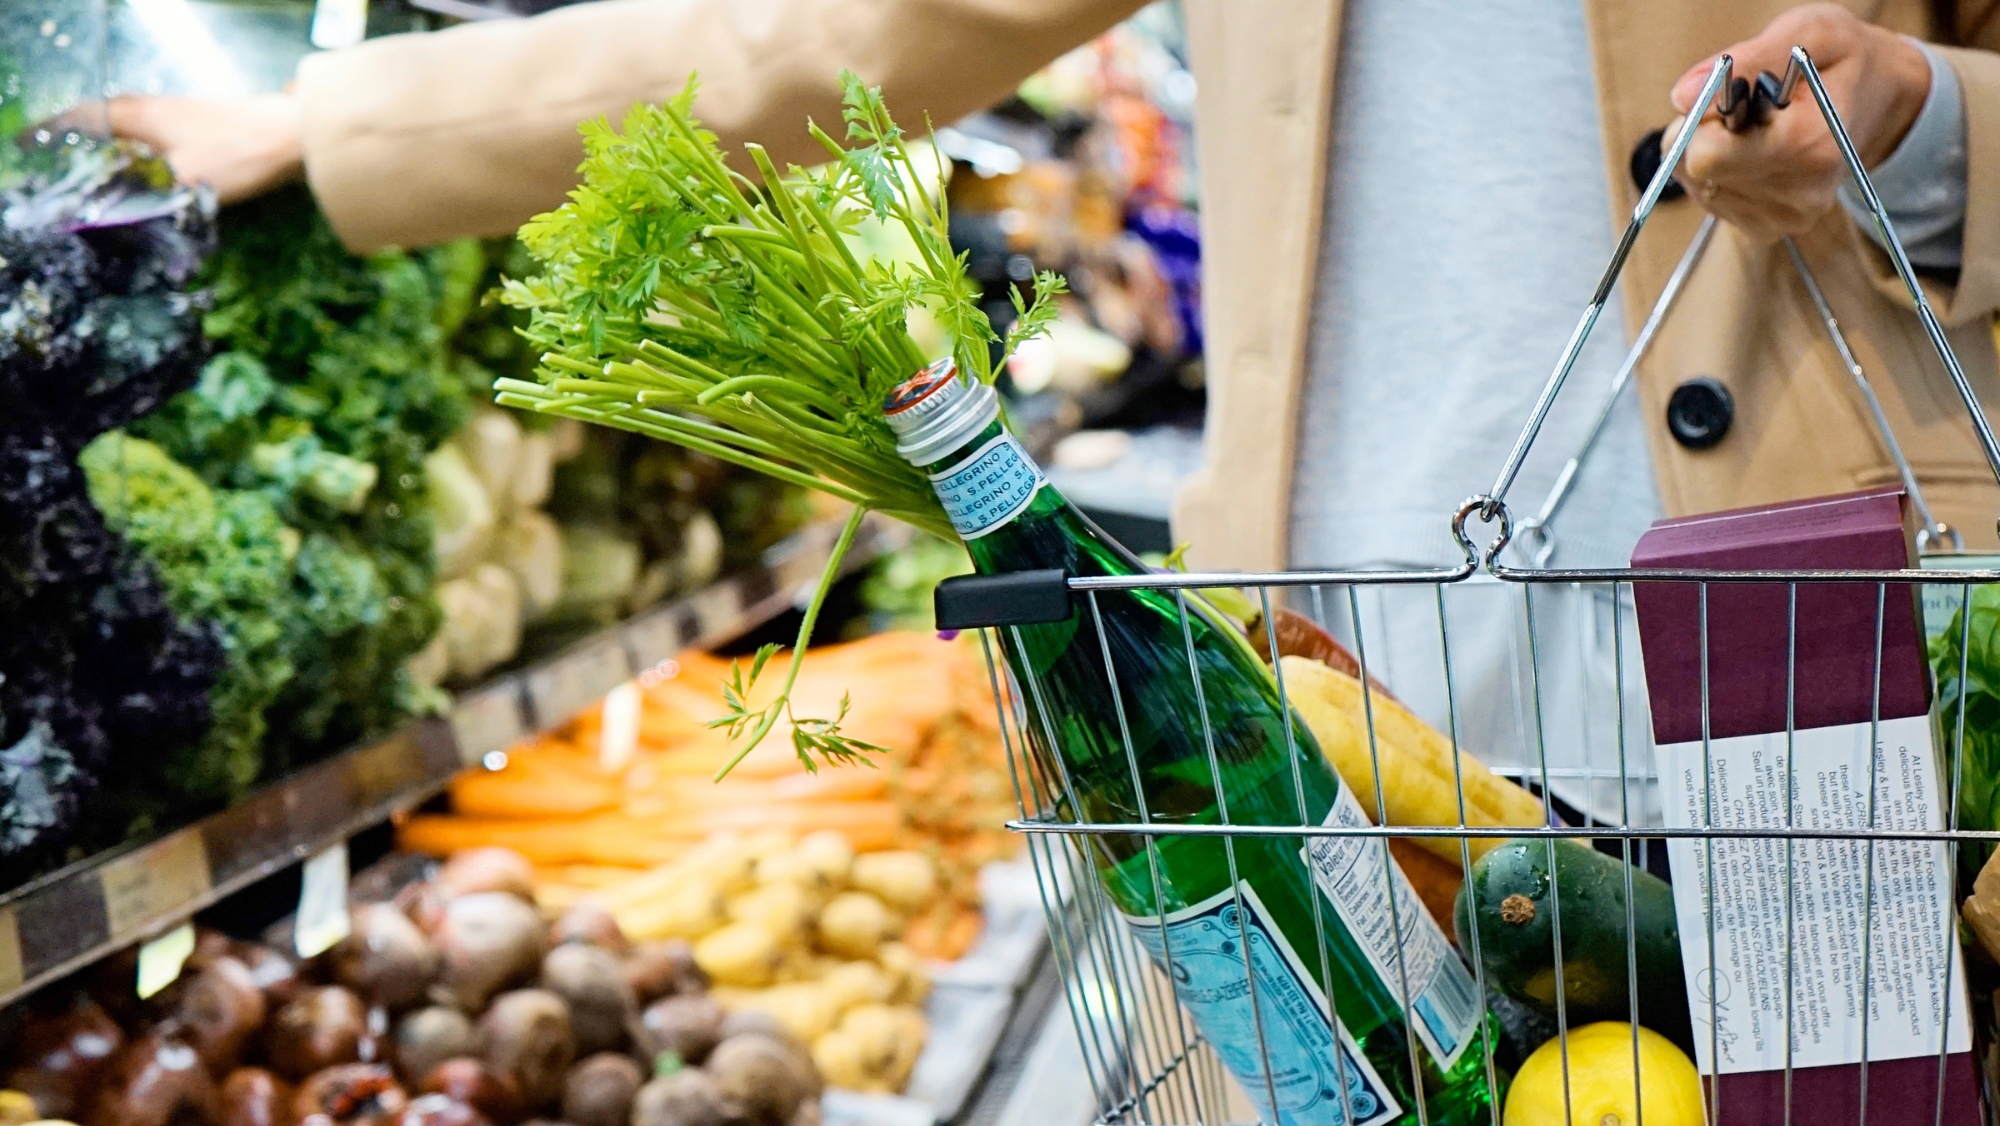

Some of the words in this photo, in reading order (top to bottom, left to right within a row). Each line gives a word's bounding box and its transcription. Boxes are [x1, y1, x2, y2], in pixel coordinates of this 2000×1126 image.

[1752, 750, 1763, 772] Seul
[1775, 755, 1784, 767] de
[1898, 746, 1910, 789] delicious
[1911, 754, 1920, 765] At
[1684, 769, 1693, 791] vous
[1716, 758, 1728, 802] Délicieux
[1755, 775, 1763, 787] un
[1765, 765, 1774, 788] avec
[1828, 771, 1838, 786] but
[1839, 764, 1849, 791] these
[1912, 768, 1923, 800] Lesley
[1687, 794, 1695, 806] ne
[1817, 771, 1827, 806] cheese
[1880, 786, 1889, 802] her
[1722, 805, 1730, 818] au
[1755, 790, 1770, 823] produit
[1768, 790, 1778, 814] soin,
[1830, 789, 1841, 815] really
[1843, 794, 1853, 826] unique
[1893, 799, 1902, 815] are
[1904, 791, 1915, 814] food.
[1772, 816, 1779, 828] en
[1793, 804, 1804, 831] Stow
[1822, 810, 1829, 819] or
[1883, 805, 1892, 830] team
[1692, 848, 1704, 868] plus
[1717, 847, 1726, 859] de
[1750, 838, 1765, 872] pouvait
[1774, 831, 1785, 863] etites
[1900, 848, 1910, 868] with
[1319, 846, 1345, 876] Valeur
[1730, 859, 1738, 876] ces
[1740, 854, 1753, 886] POUR
[1838, 847, 1848, 872] when
[1877, 847, 1889, 881] scratch
[1890, 859, 1899, 874] the
[1912, 851, 1923, 891] fabulous
[1698, 872, 1707, 894] vous
[1719, 862, 1733, 910] trempette,
[1767, 864, 1780, 902] fabriqué
[1801, 861, 1812, 890] Foods
[1819, 873, 1827, 888] are
[1830, 870, 1839, 886] We
[1853, 873, 1862, 888] are
[1892, 877, 1902, 897] only
[1903, 870, 1912, 892] care
[1924, 861, 1936, 891] Foods
[1732, 878, 1746, 927] craquelins
[1745, 888, 1756, 911] CES
[1757, 876, 1769, 918] satisfaire
[1792, 881, 1803, 922] fabuleux
[1821, 891, 1830, 912] sure
[1832, 889, 1840, 905] are
[1841, 875, 1854, 908] topped
[1882, 884, 1892, 910] using
[1906, 894, 1914, 903] in
[1929, 894, 1936, 907] we
[1772, 905, 1782, 928] avec
[1805, 893, 1815, 920] adore
[1895, 900, 1904, 918] way
[1918, 894, 1927, 922] crisps
[1726, 913, 1735, 925] de
[1748, 914, 1760, 938] FINS
[1822, 915, 1833, 932] you
[1835, 908, 1848, 949] addicted
[1846, 911, 1857, 930] with
[1885, 913, 1894, 928] our
[1898, 922, 1906, 931] to
[1907, 906, 1919, 932] small
[1931, 910, 1940, 930] love
[1728, 928, 1739, 967] fromage
[1740, 930, 1750, 950] sont
[1763, 922, 1774, 951] Lesley
[1776, 931, 1785, 948] des
[1809, 924, 1821, 965] fabriquer
[1827, 935, 1837, 950] will
[1847, 932, 1858, 952] your
[1888, 931, 1899, 957] finest
[1900, 934, 1910, 960] make
[1922, 925, 1930, 947] from
[1768, 955, 1777, 964] et
[1798, 924, 1811, 973] craquelins
[1829, 953, 1838, 965] be
[1841, 952, 1849, 961] to
[1911, 935, 1922, 975] batches.
[1934, 933, 1945, 968] making
[1734, 970, 1742, 982] ou
[1743, 954, 1756, 1006] irrésistibles
[1752, 941, 1770, 1011] CRAQUELINS
[1769, 967, 1778, 984] son
[1790, 953, 1801, 986] cuisine
[1815, 969, 1824, 978] et
[1831, 968, 1840, 984] too.
[1842, 963, 1852, 980] this
[1925, 950, 1937, 988] Lesley's
[1795, 989, 1804, 1001] de
[1805, 976, 1815, 996] sont
[1817, 981, 1826, 1003] vous
[1890, 960, 1906, 1014] ingredients.
[1902, 972, 1916, 996] great
[1842, 983, 1855, 1018] yummy
[1870, 1001, 1879, 1021] own
[1930, 991, 1941, 1026] kitchen
[1808, 999, 1821, 1044] fabriqués
[1820, 1006, 1830, 1027] offrir
[1906, 1000, 1921, 1035] product
